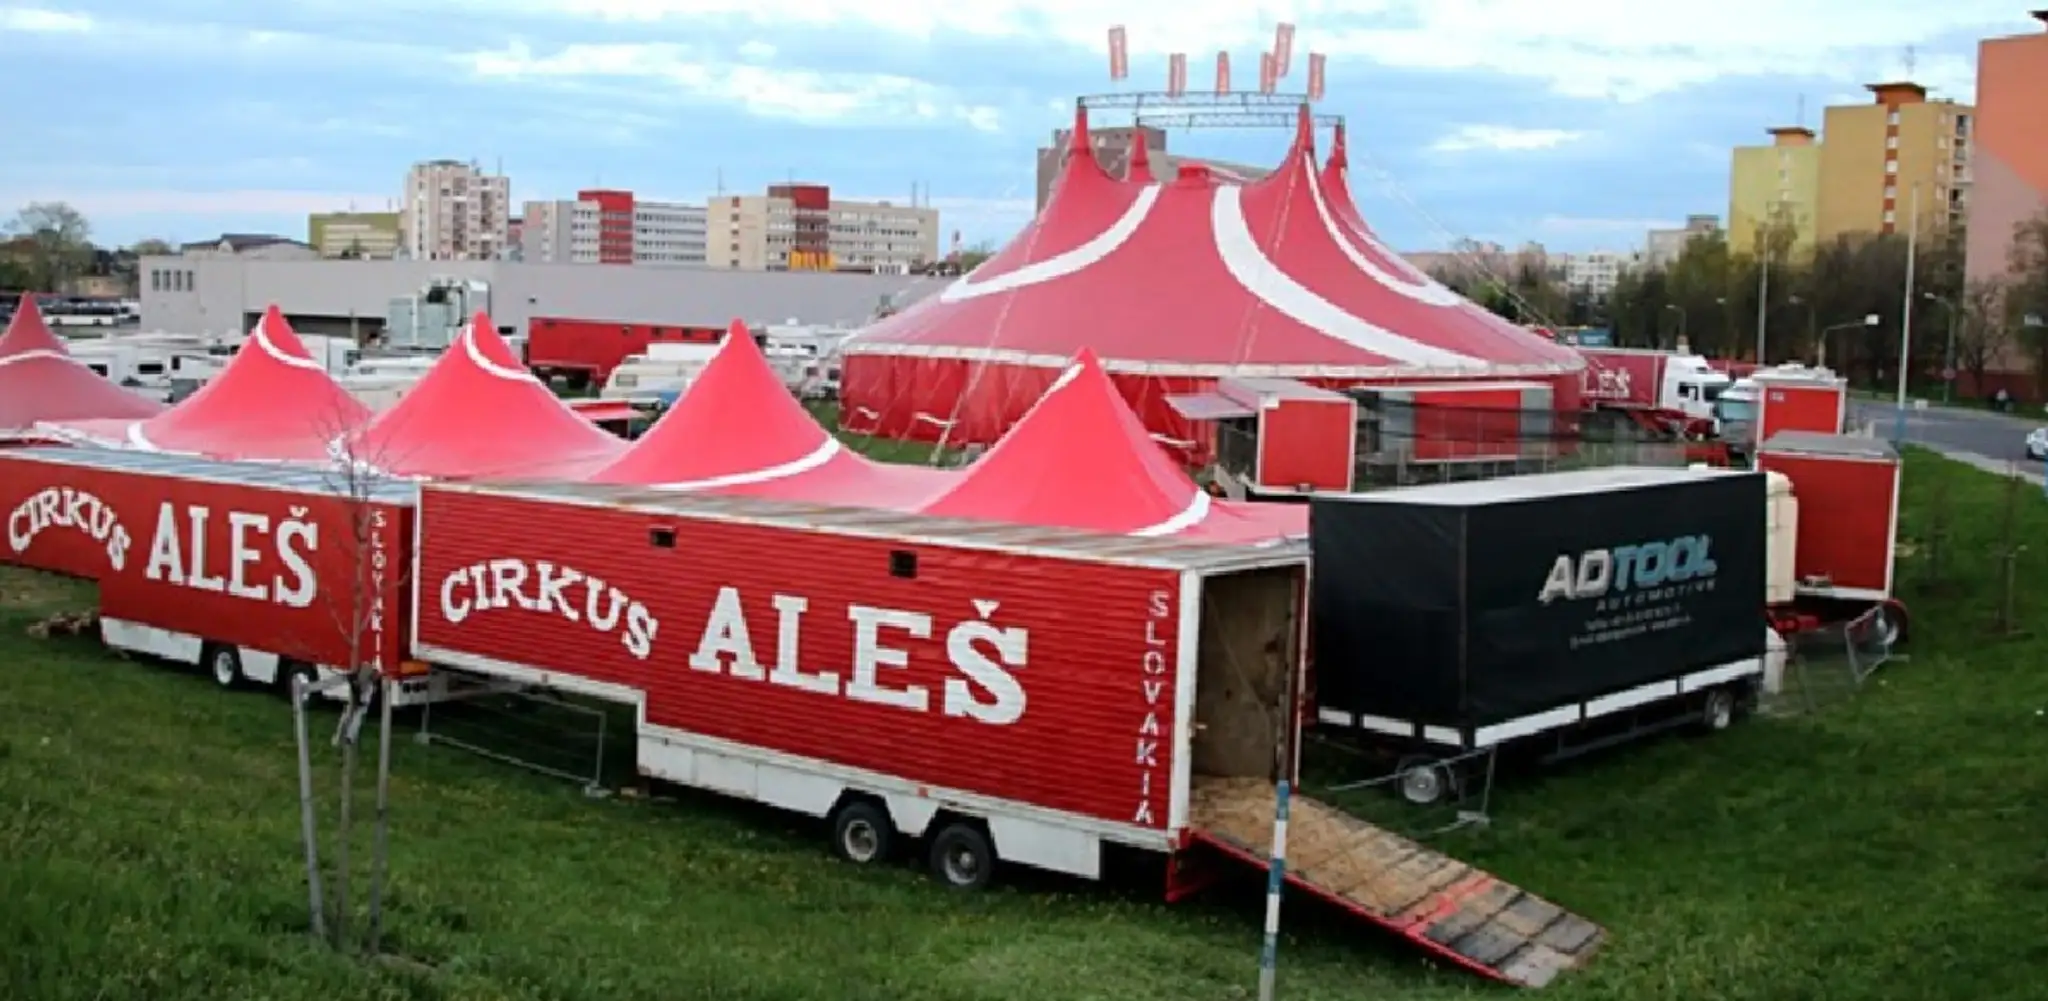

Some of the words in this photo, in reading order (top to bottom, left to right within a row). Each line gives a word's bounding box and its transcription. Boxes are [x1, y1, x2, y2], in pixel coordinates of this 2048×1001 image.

[8, 486, 132, 571] CIRKUS
[145, 501, 319, 608] ALEŠ
[371, 510, 387, 672] SLOVAKIA
[440, 559, 658, 659] CIRKUS
[689, 587, 1029, 724] ALEŠ
[1134, 591, 1170, 825] SLOVAKIA
